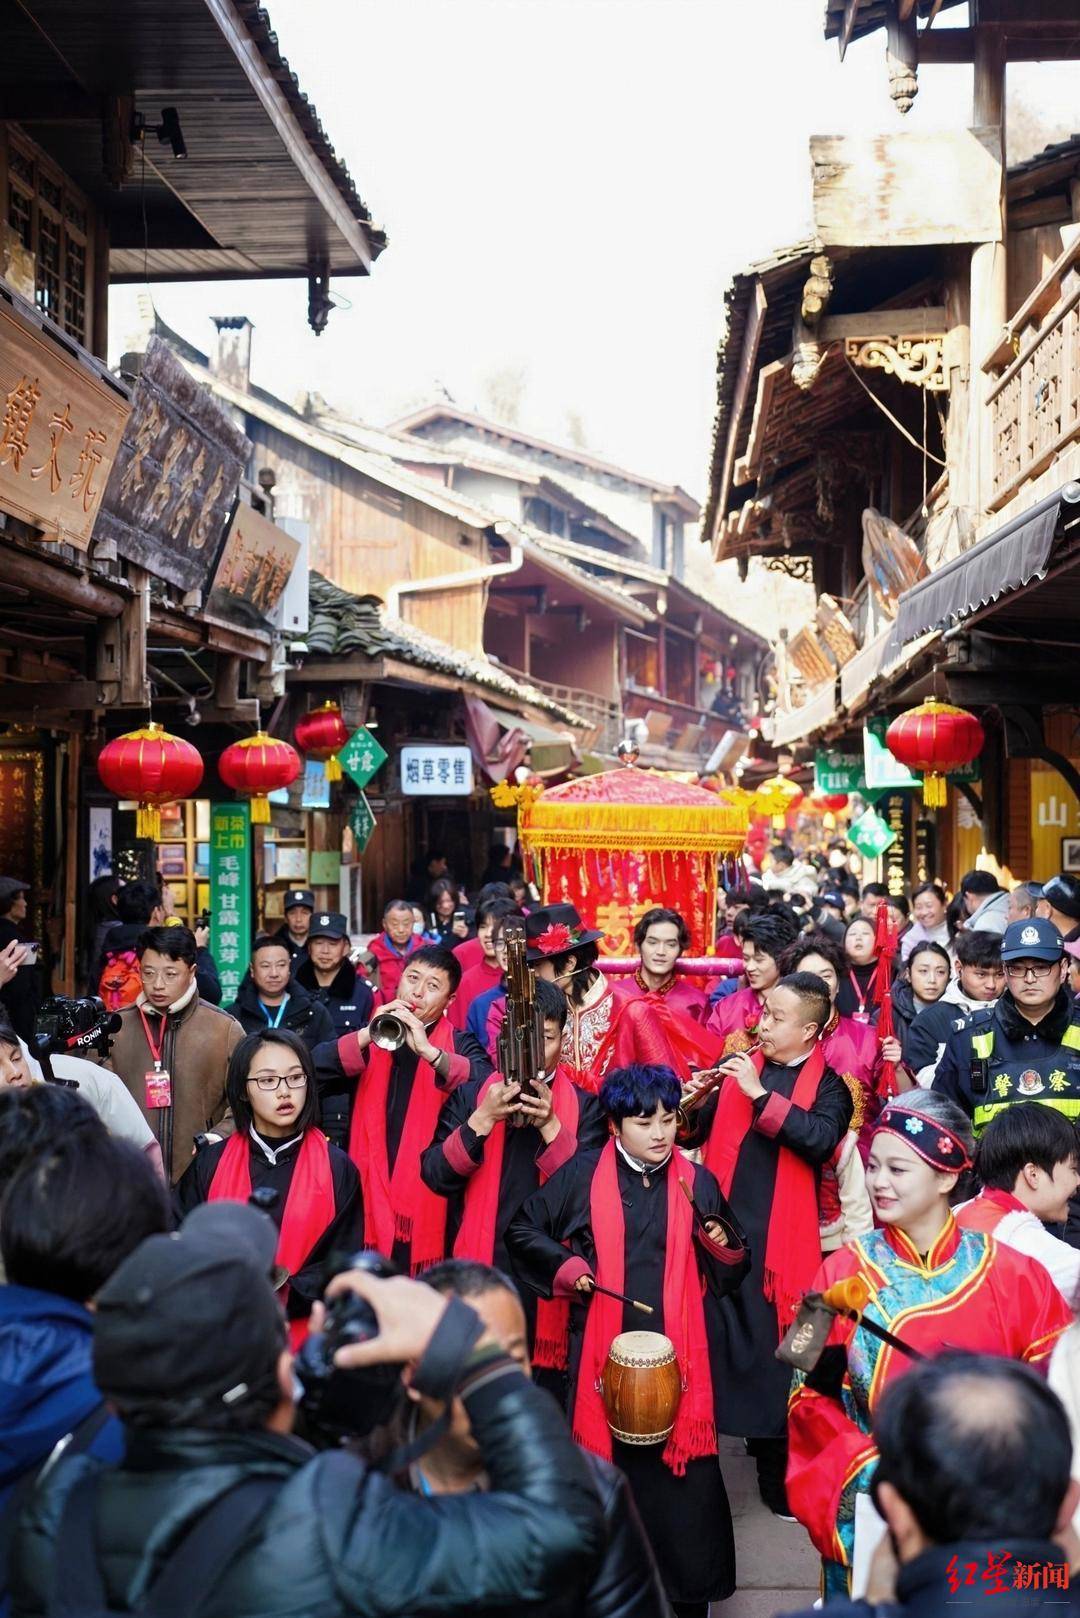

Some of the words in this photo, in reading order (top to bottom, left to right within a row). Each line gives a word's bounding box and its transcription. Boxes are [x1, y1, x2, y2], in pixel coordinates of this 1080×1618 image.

[406, 757, 465, 785] 烟草零售
[214, 815, 245, 832] 新茶
[214, 833, 245, 849] 上市
[76, 1027, 102, 1046] RONIN
[1048, 1070, 1072, 1093] 察
